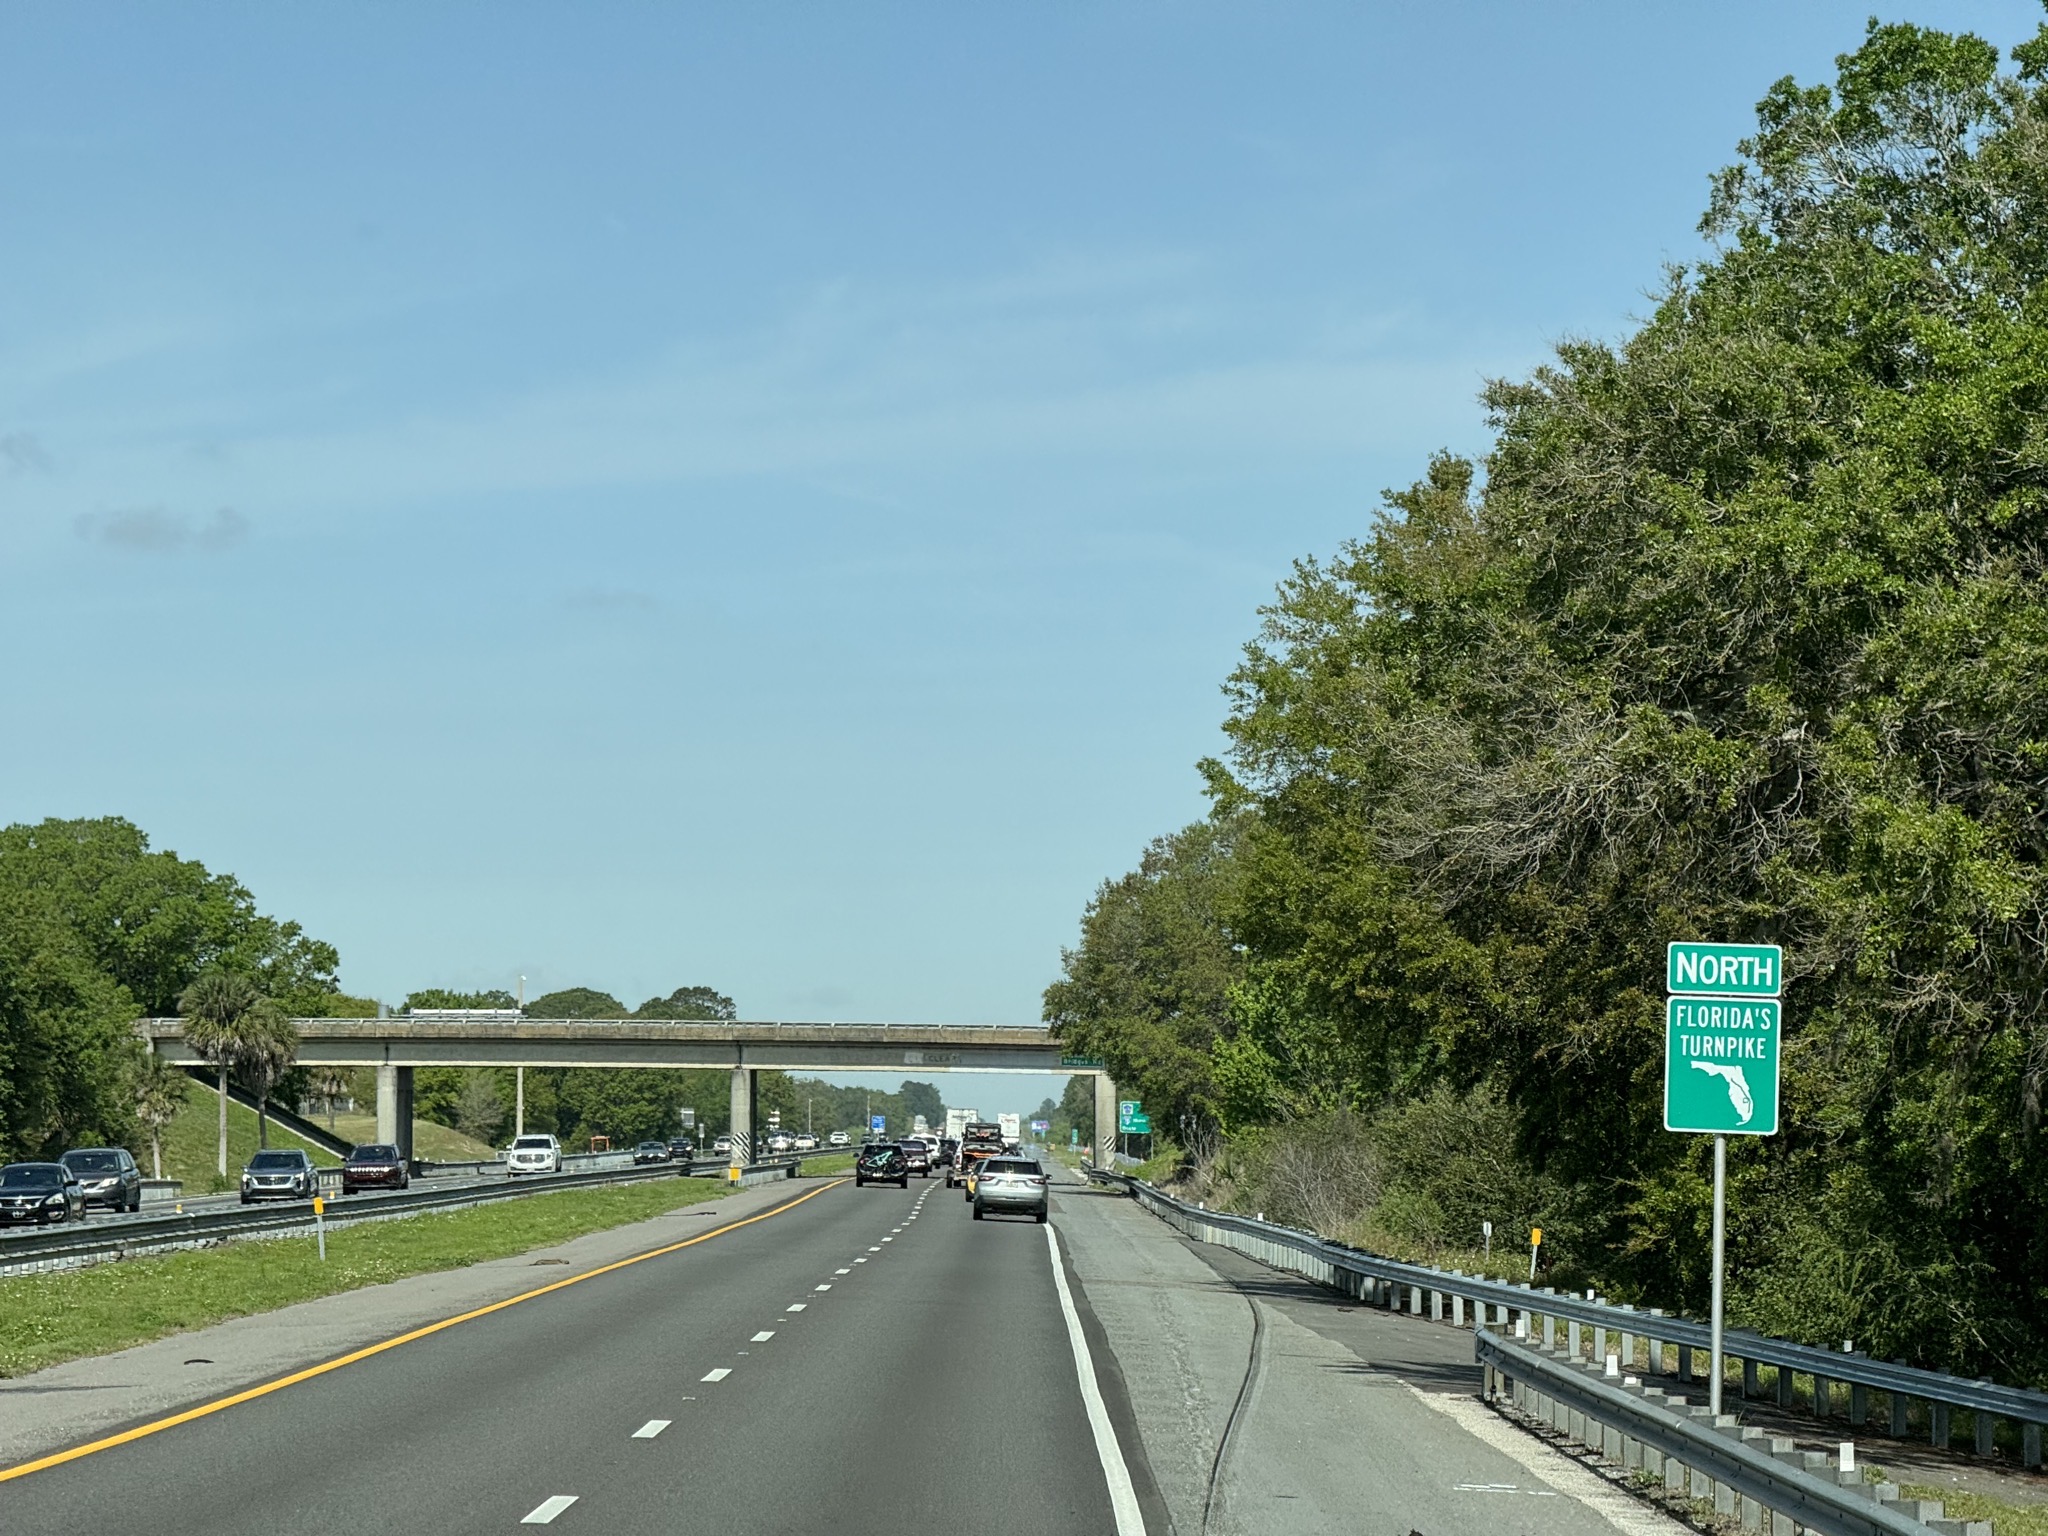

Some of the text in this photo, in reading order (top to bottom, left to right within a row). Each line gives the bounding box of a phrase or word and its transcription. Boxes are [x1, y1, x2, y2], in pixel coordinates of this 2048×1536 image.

[1676, 951, 1773, 986] NORTH
[1676, 1005, 1771, 1030] FLORIDA'S
[1680, 1034, 1767, 1059] TURNPIKE
